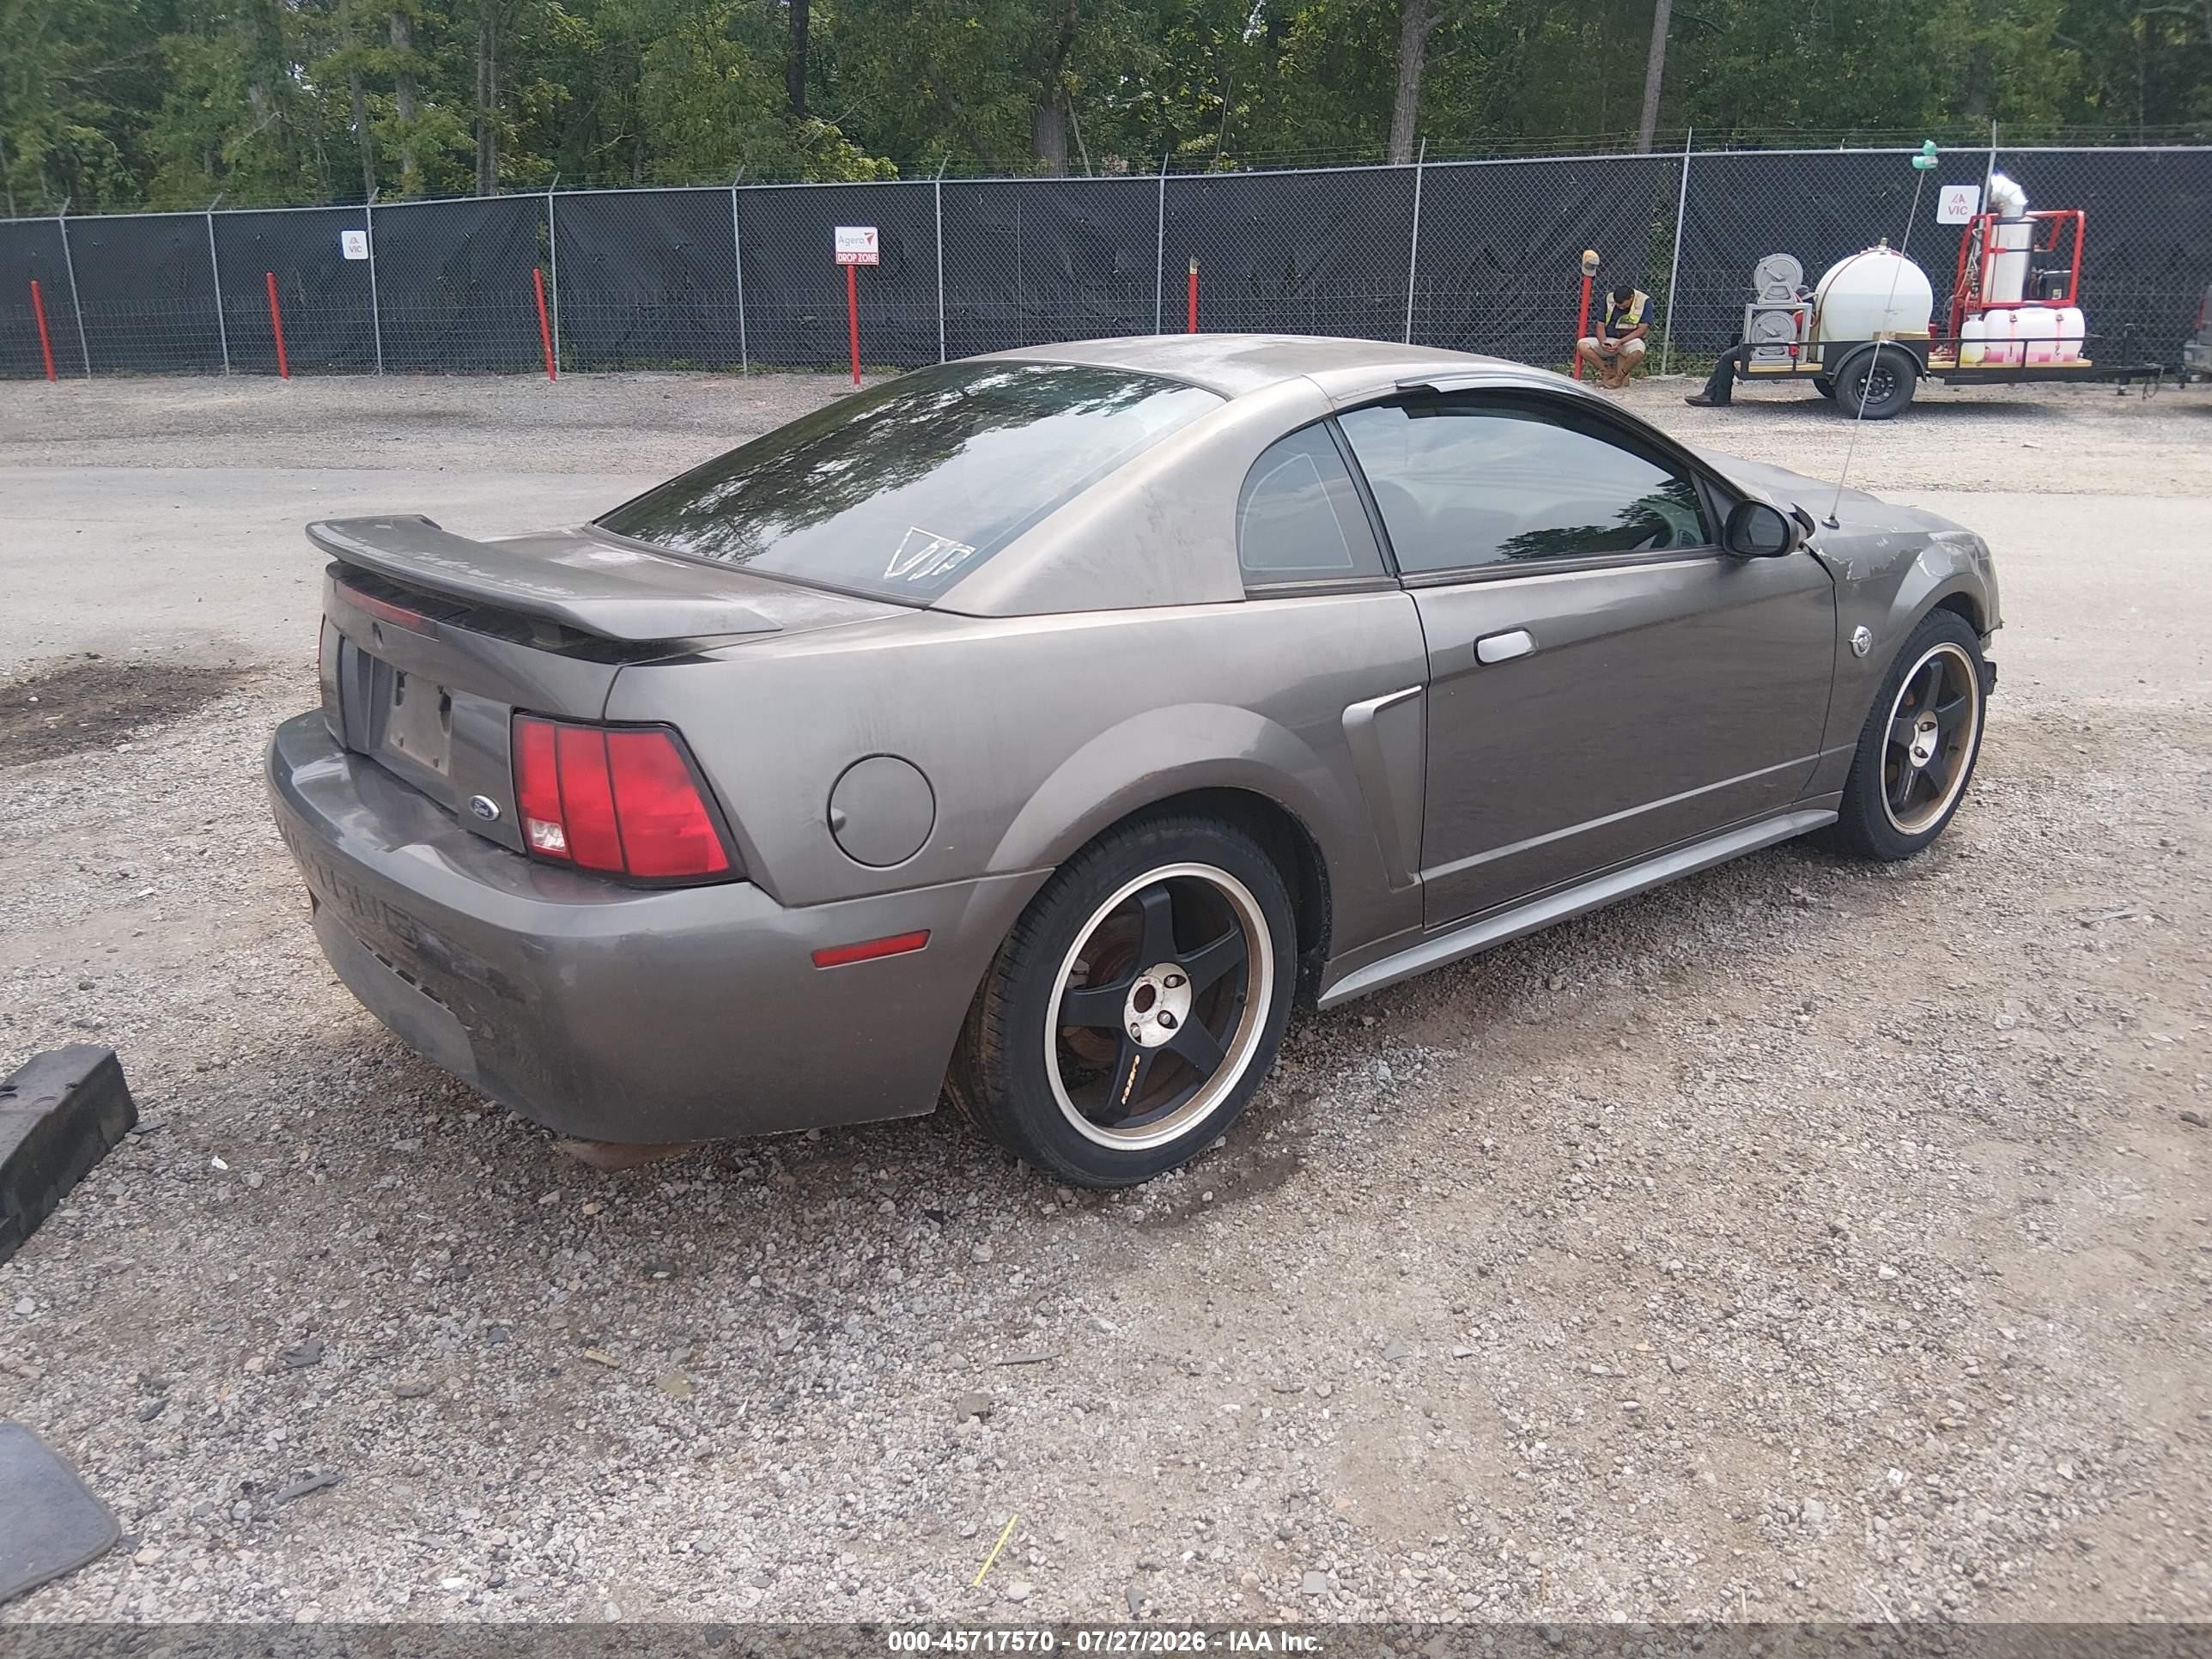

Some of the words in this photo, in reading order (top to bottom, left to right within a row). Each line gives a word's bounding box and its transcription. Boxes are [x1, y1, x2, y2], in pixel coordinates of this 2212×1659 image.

[1948, 205, 1968, 215] VIC
[838, 235, 865, 246] Agero
[838, 253, 858, 263] DROP
[858, 253, 878, 263] ZONE
